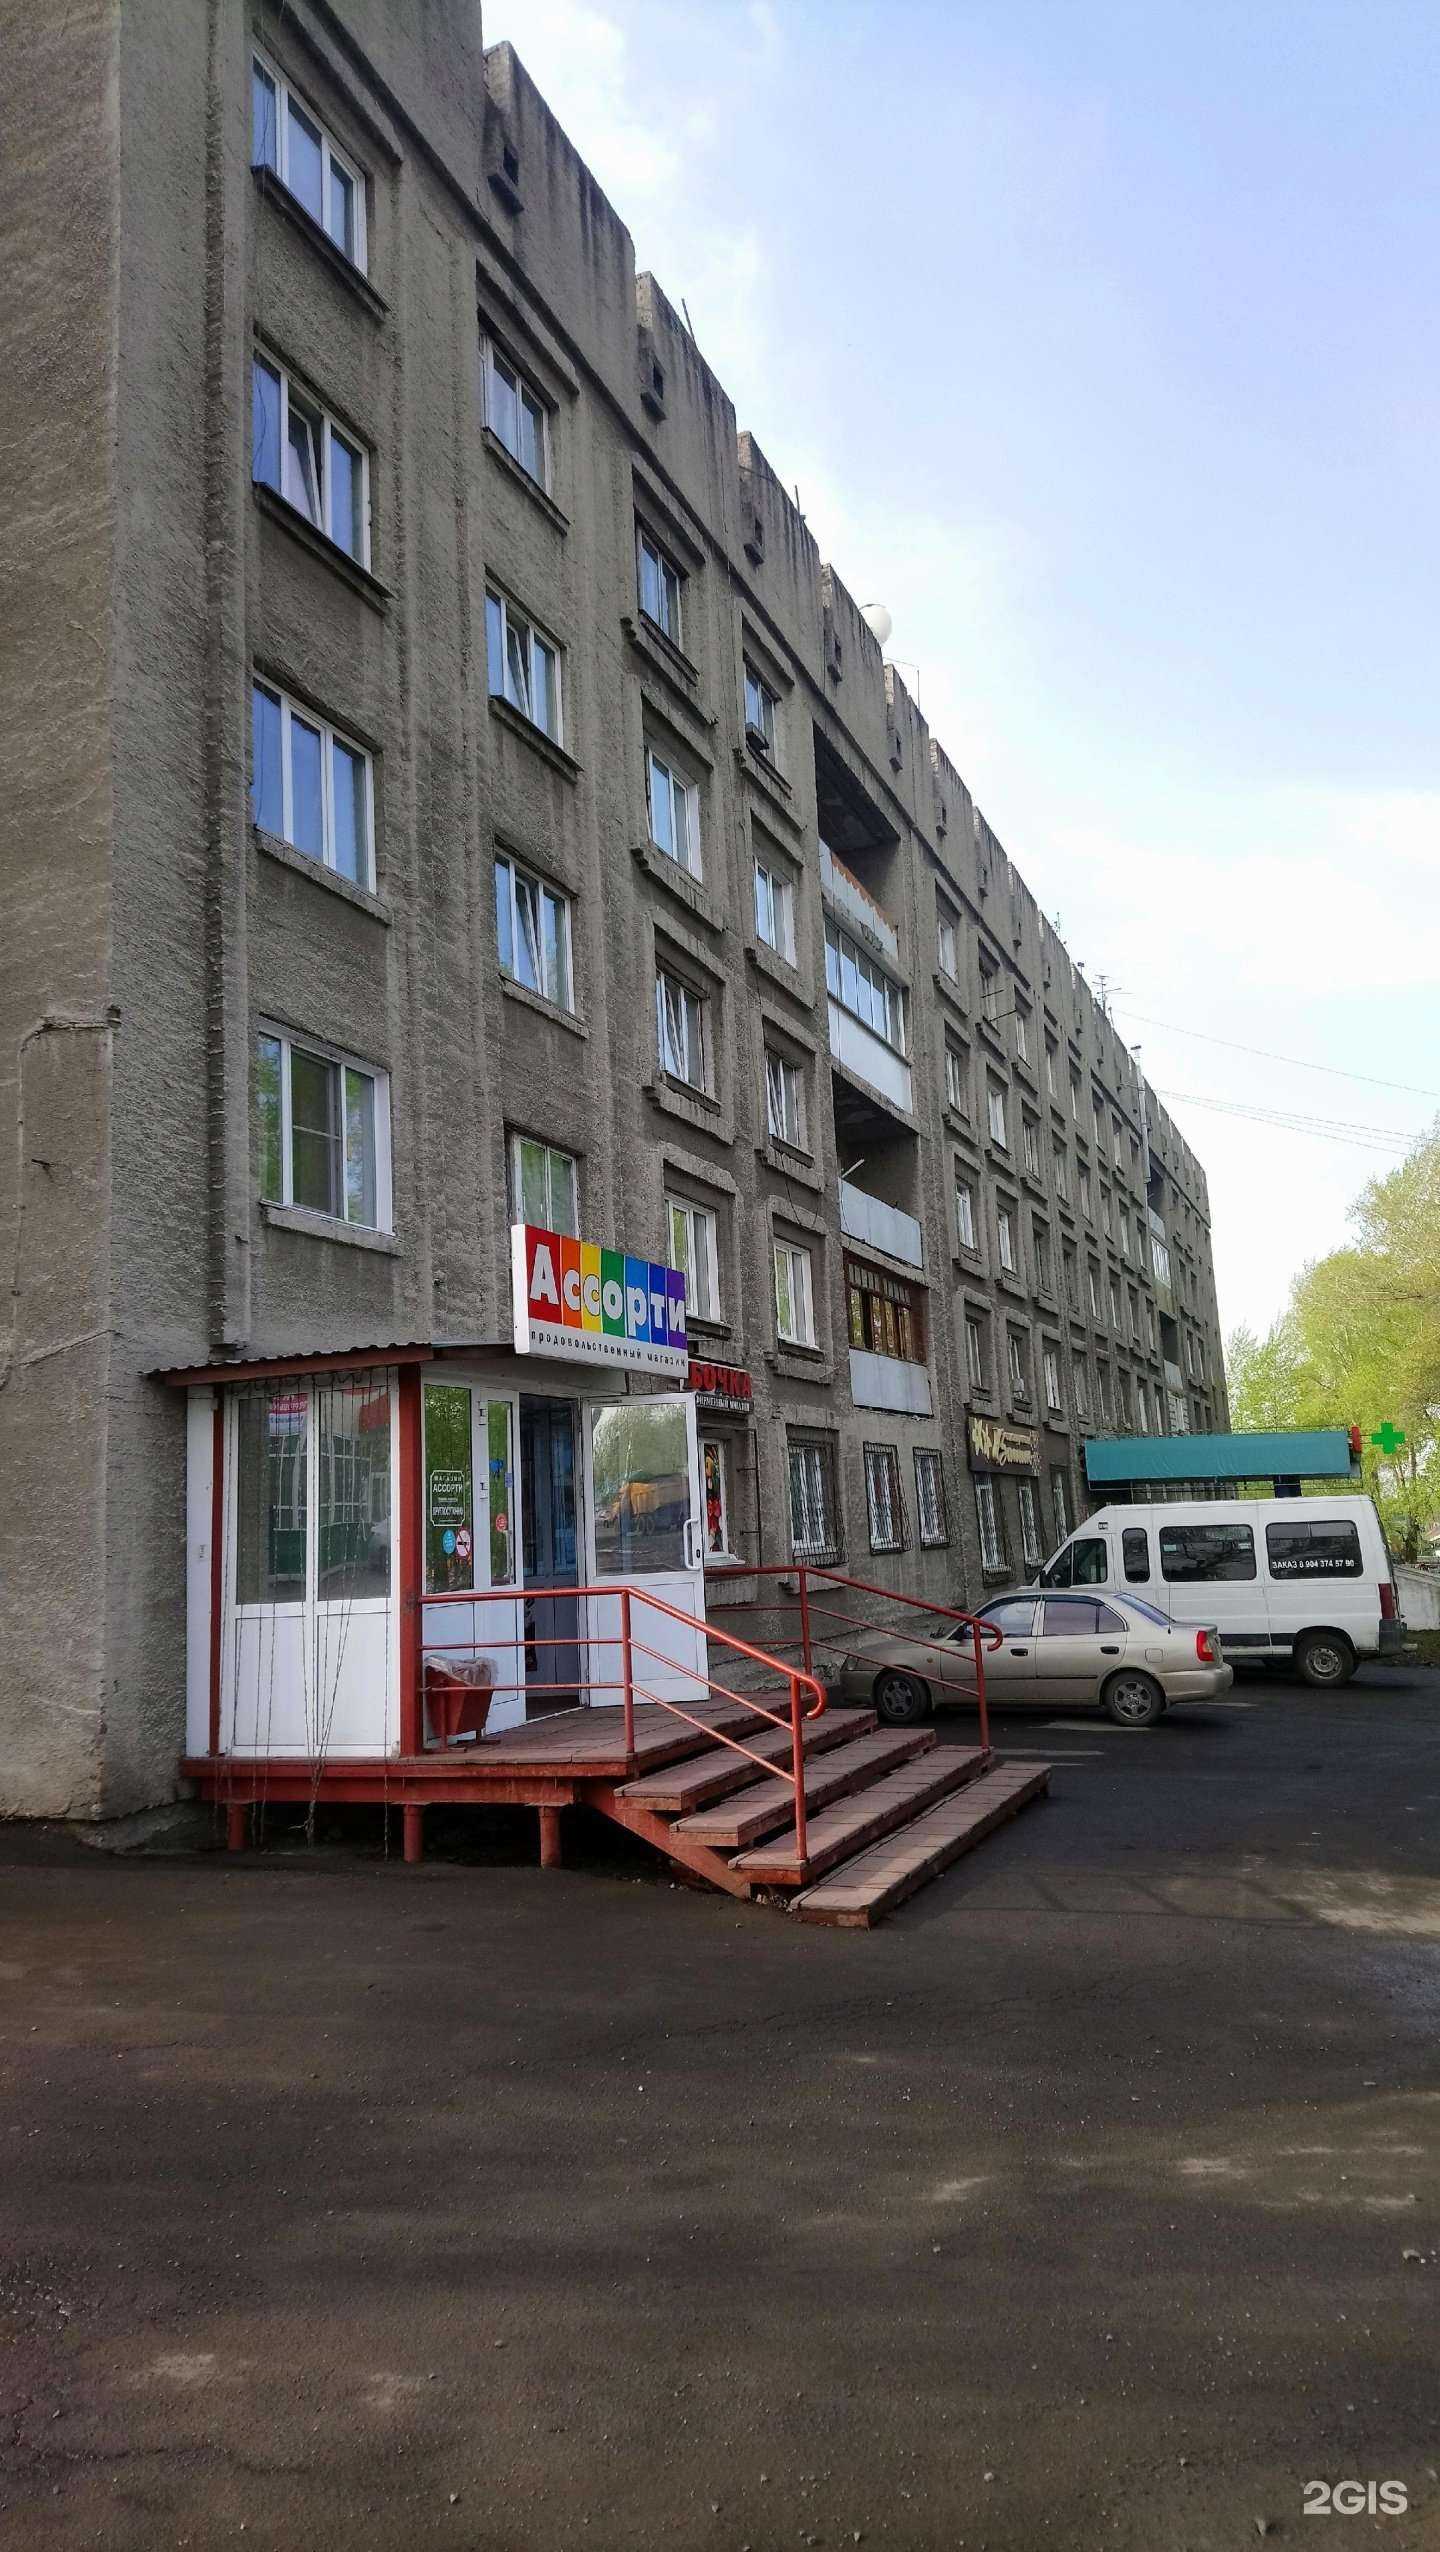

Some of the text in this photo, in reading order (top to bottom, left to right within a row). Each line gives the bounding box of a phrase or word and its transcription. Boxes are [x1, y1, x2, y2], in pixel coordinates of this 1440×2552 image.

[530, 1243, 685, 1337] Ассорти
[531, 1330, 686, 1367] продовольственный магазин
[689, 1361, 752, 1397] БОЧКА
[433, 1484, 462, 1493] АССОРТИ
[1272, 1561, 1298, 1569] ЗАКАЗ
[1320, 1559, 1334, 1567] 374
[1335, 1559, 1344, 1567] 57
